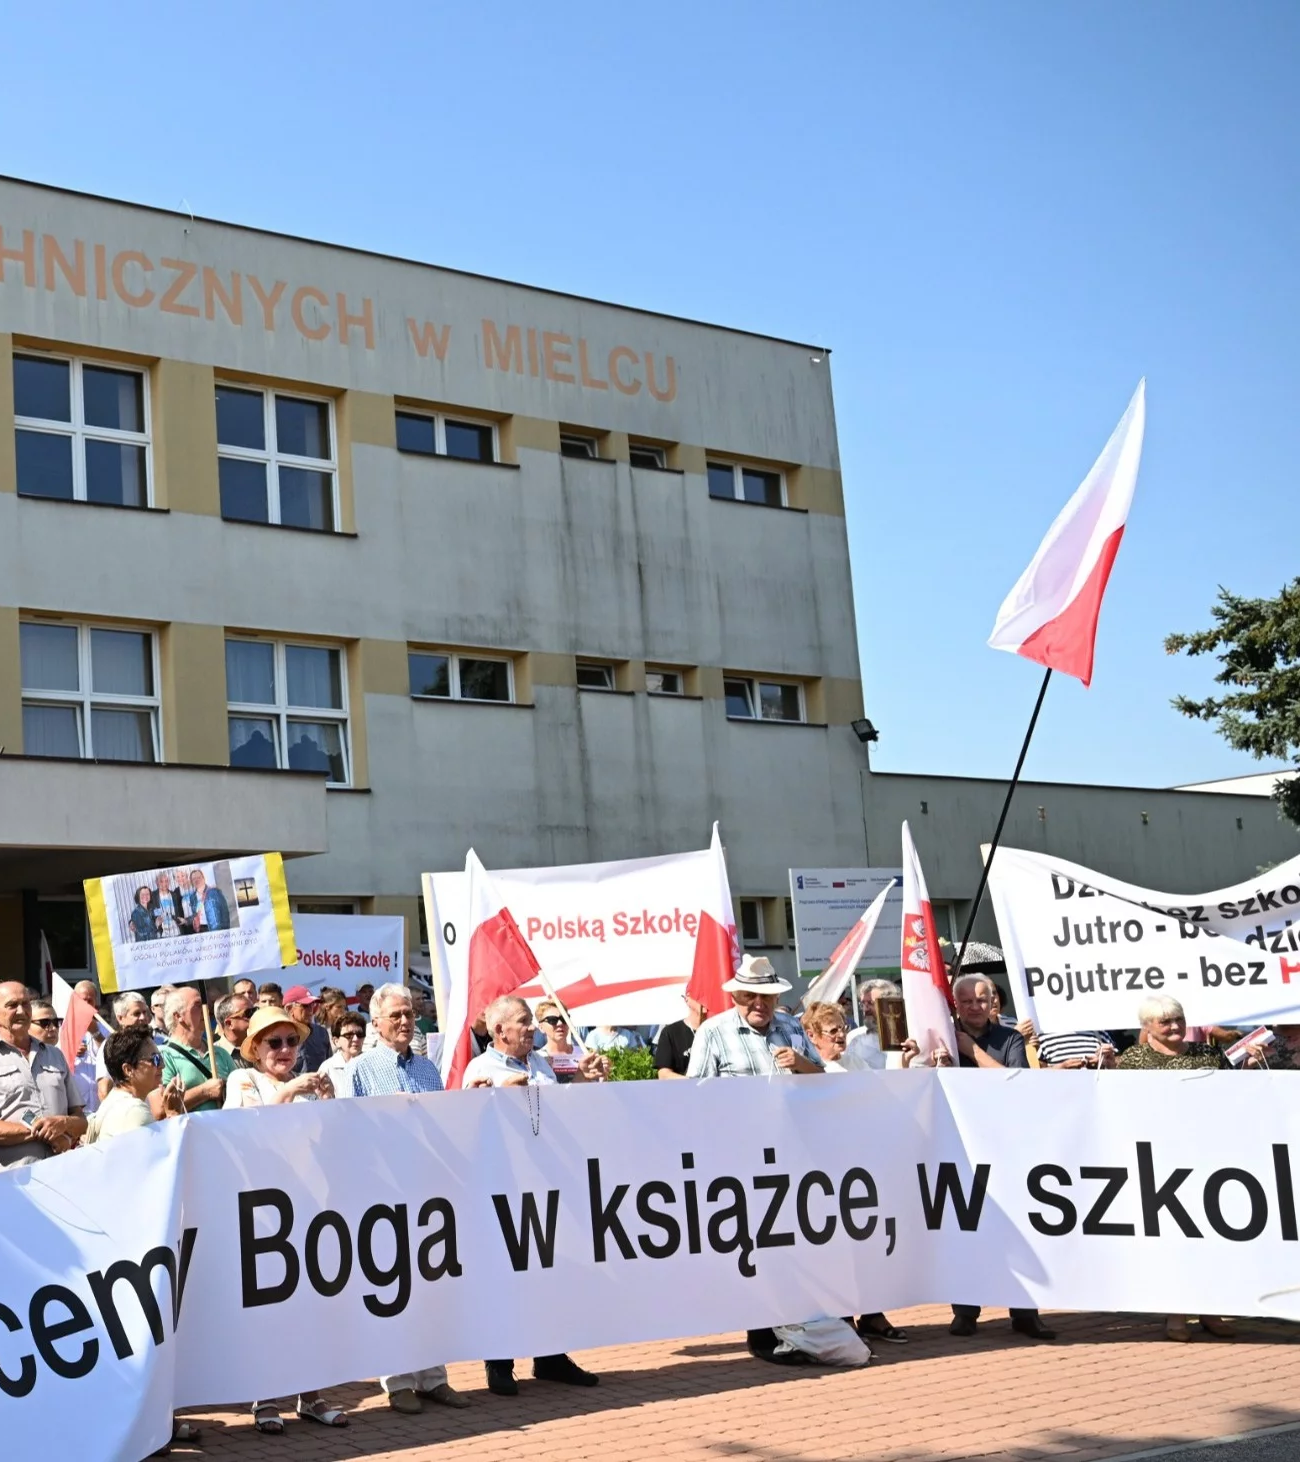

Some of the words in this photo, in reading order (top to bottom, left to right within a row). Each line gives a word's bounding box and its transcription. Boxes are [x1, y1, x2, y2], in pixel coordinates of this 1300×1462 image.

[482, 318, 677, 401] MIELCU
[1217, 885, 1300, 919] szko
[527, 914, 606, 943] Polską
[612, 907, 698, 938] Szkołę
[1053, 915, 1144, 947] Jutro
[1245, 919, 1300, 954] dzi
[296, 948, 341, 971] Polską
[345, 949, 391, 972] Szkołę
[1025, 962, 1165, 1001] Pojutrze
[1199, 955, 1268, 987] bez
[237, 1187, 463, 1318] Boga
[491, 1189, 560, 1272] w
[587, 1147, 897, 1278] książce,
[916, 1162, 991, 1232] w
[1026, 1141, 1299, 1242] szkol
